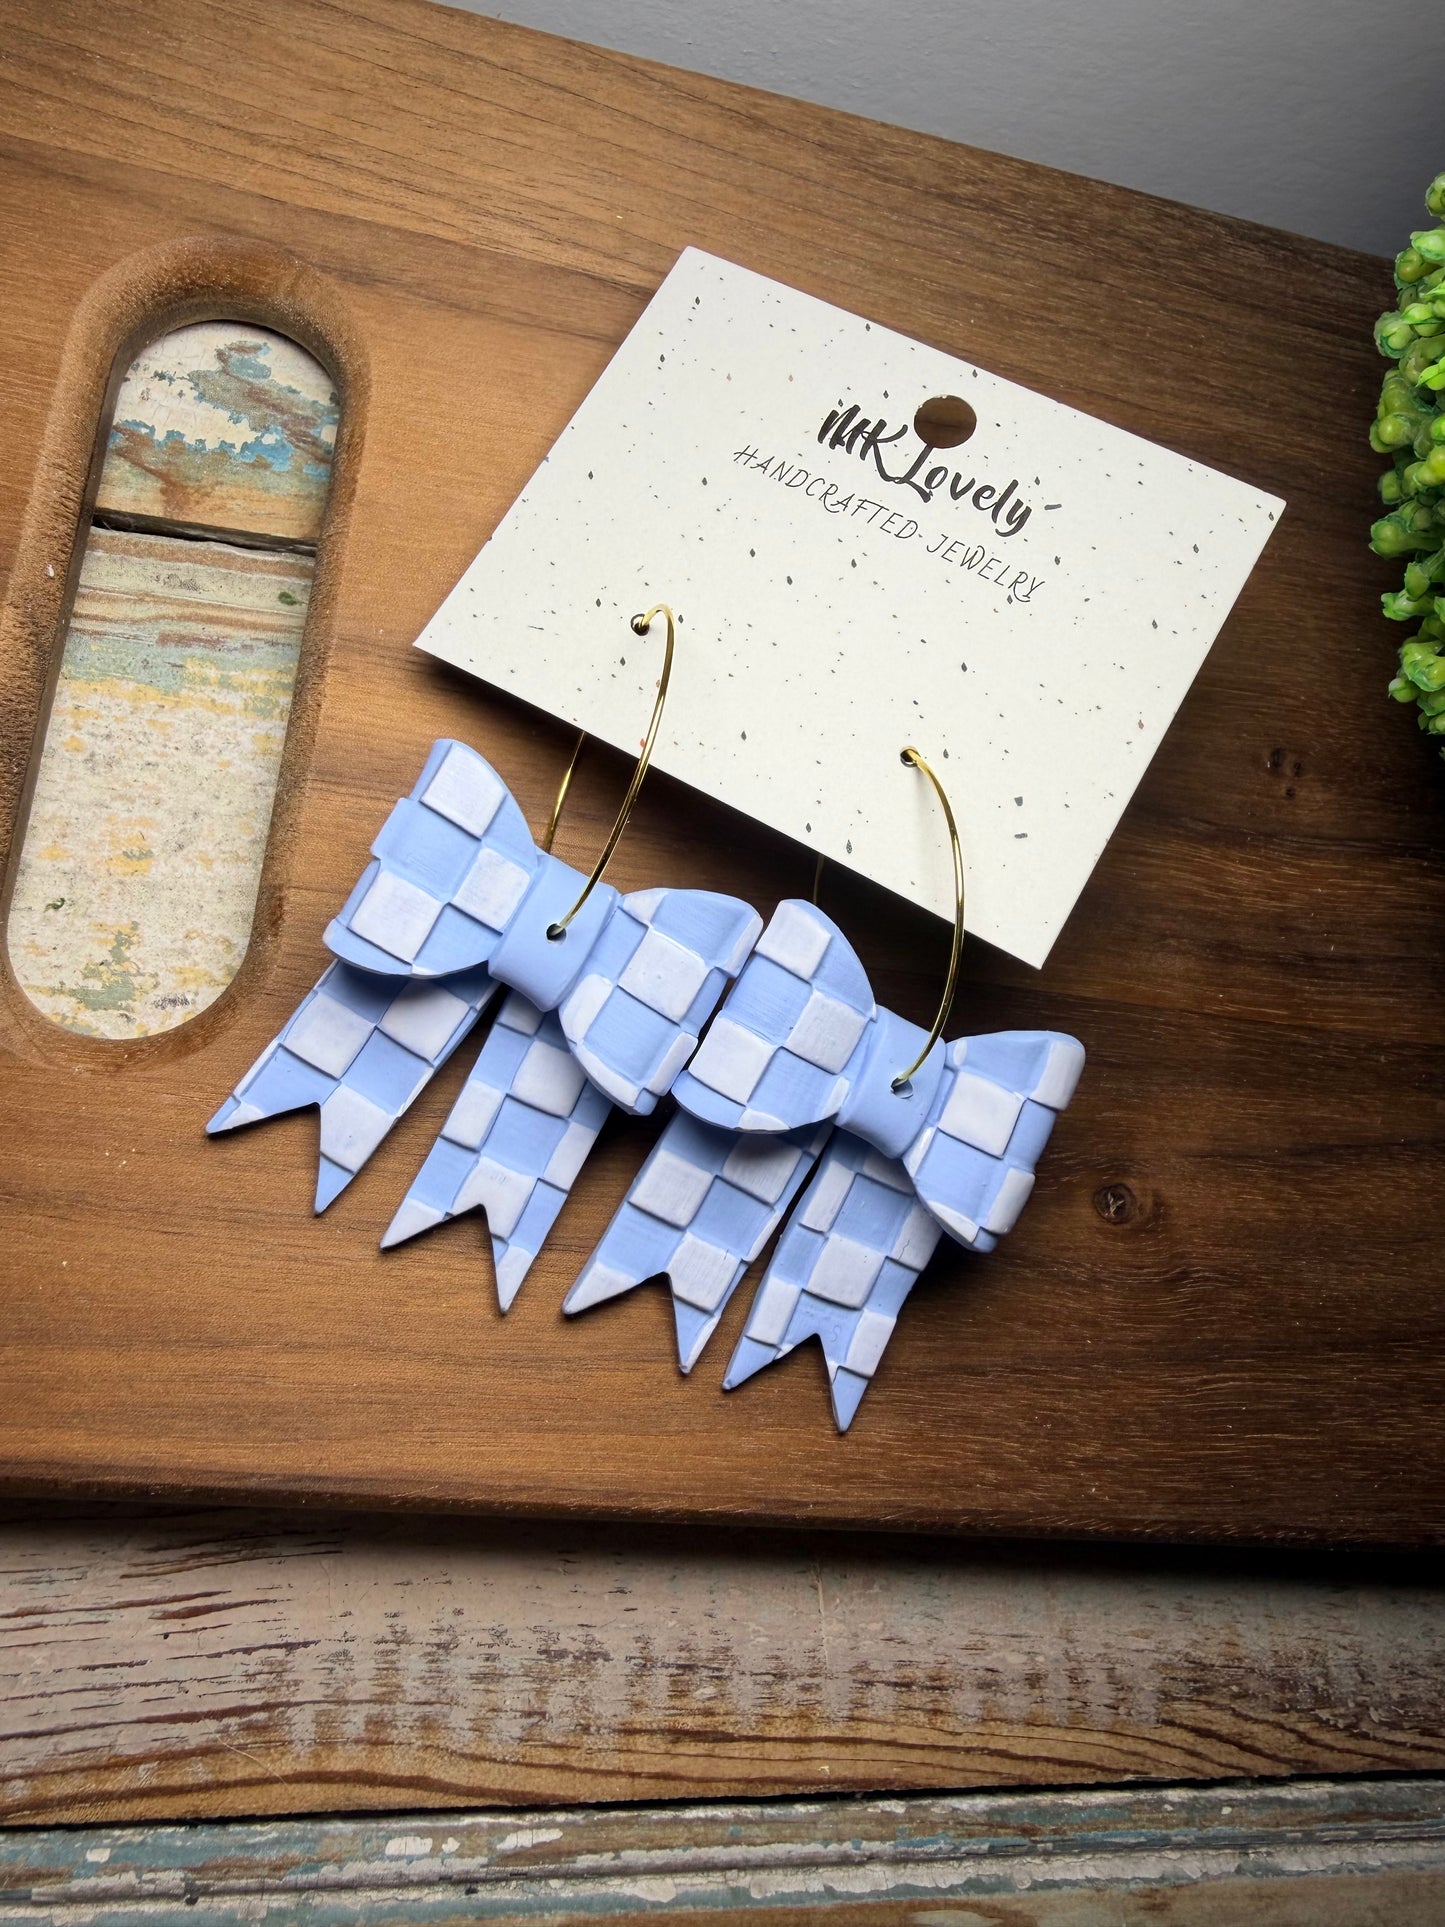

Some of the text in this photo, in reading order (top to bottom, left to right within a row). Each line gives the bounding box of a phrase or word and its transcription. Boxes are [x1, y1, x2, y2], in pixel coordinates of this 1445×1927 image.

[733, 445, 1045, 603] HANDCRAFTED JEWELRY
[900, 444, 1032, 537] Lovely
